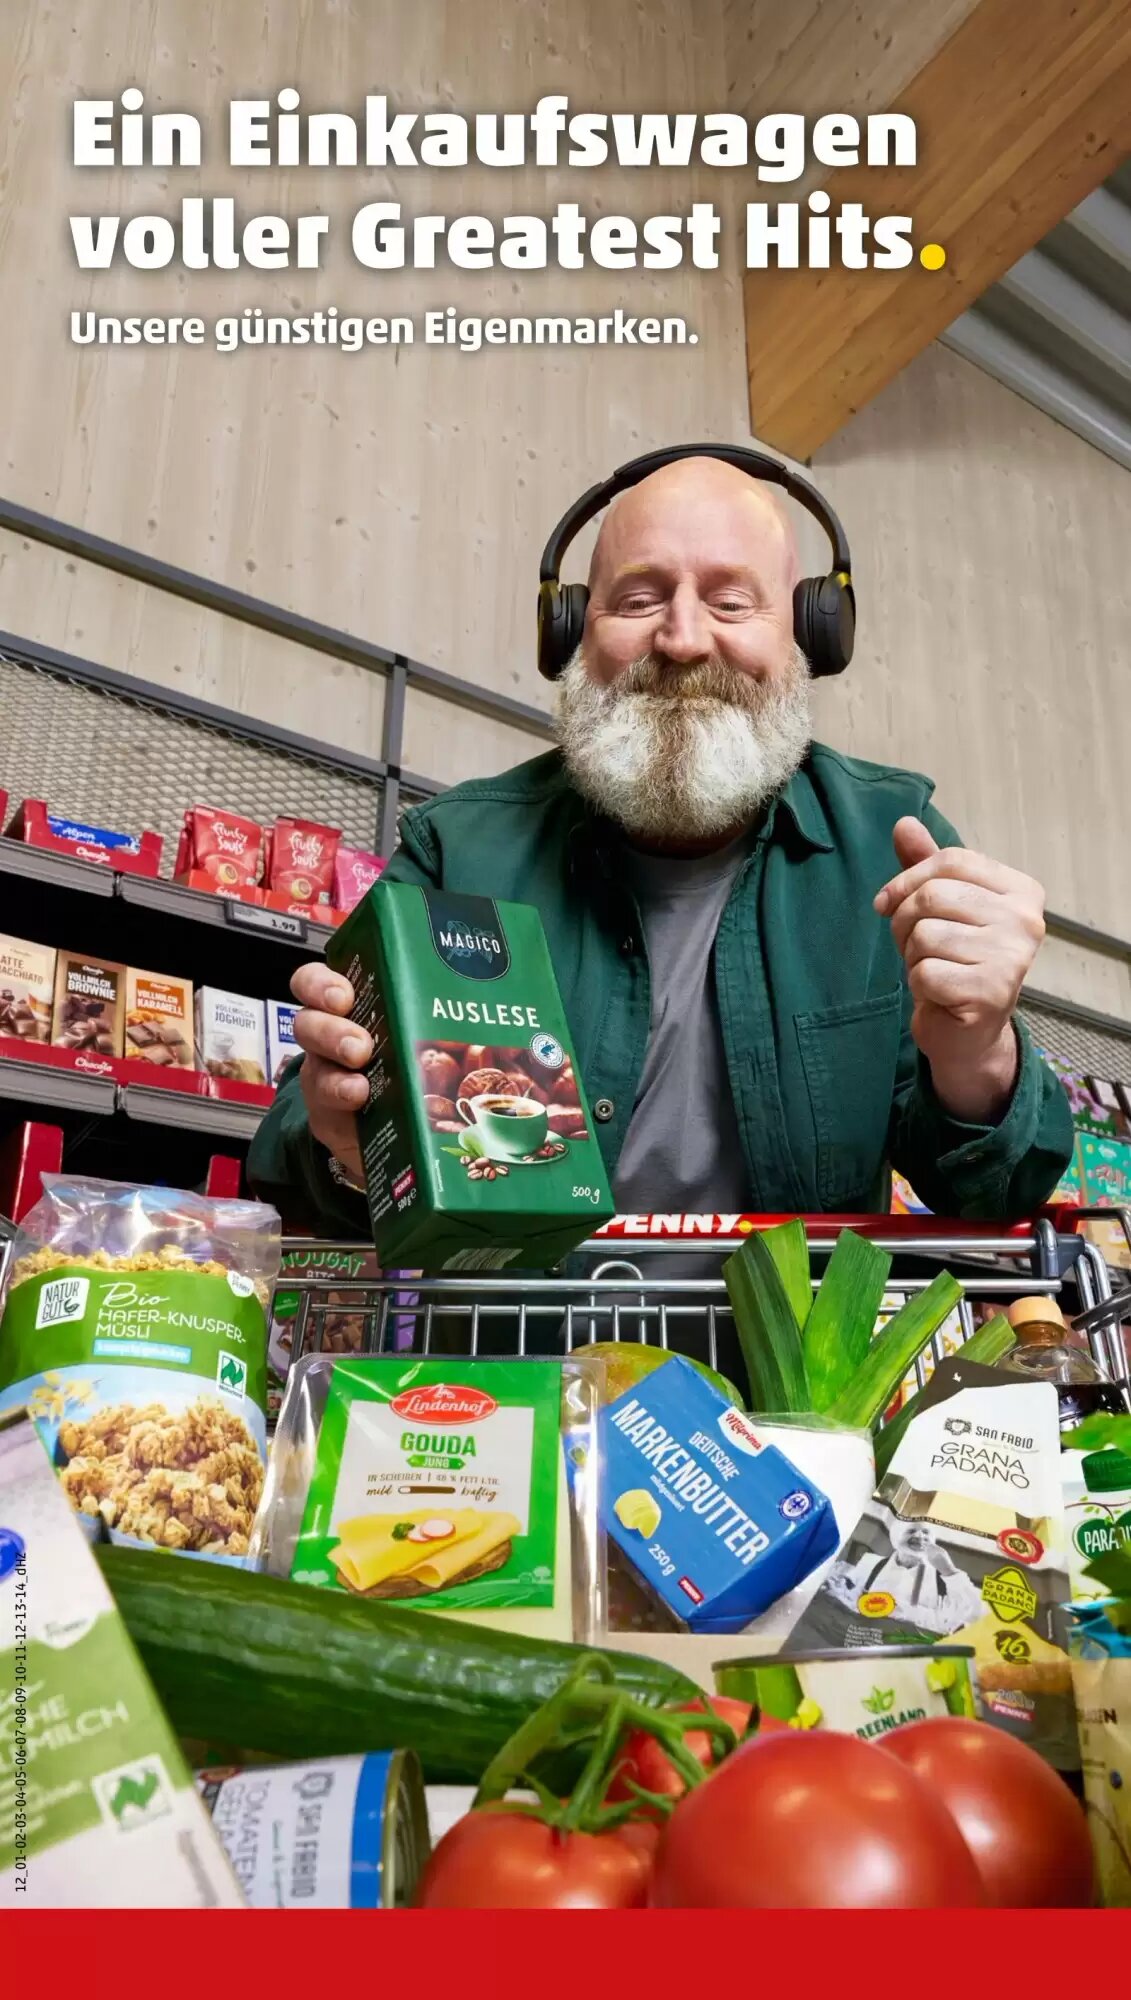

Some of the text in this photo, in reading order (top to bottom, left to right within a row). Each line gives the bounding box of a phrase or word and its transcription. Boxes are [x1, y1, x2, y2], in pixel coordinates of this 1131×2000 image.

[271, 919, 296, 932] 1.99
[439, 931, 501, 954] MAGICO
[67, 971, 112, 989] VOLLMILCH
[67, 980, 117, 1000] BROWNIE
[137, 998, 184, 1017] KARAMELL
[432, 997, 541, 1028] AUSLESE
[214, 1012, 257, 1031] JOGHURT
[280, 1251, 367, 1278] NOUGAT
[45, 1281, 80, 1302] NATUR
[99, 1281, 170, 1308] Bio
[42, 1300, 65, 1321] GUT
[95, 1322, 151, 1339] MÜSLI
[97, 1308, 247, 1344] HAFER-KNUSPER-
[401, 1394, 489, 1416] Lindenhof
[726, 1412, 762, 1451] Milprima
[975, 1426, 998, 1440] SAN
[1001, 1432, 1034, 1449] FABIO
[400, 1432, 477, 1457] GOUDA
[423, 1455, 450, 1468] JUNG
[688, 1431, 742, 1482] DEUTSCHE
[940, 1441, 1026, 1475] GRANA
[380, 1472, 422, 1482] SCHEIBEN
[610, 1399, 771, 1565] MARKENBUTTER
[930, 1454, 1031, 1489] PADANO
[366, 1485, 393, 1496] mild
[648, 1543, 671, 1567] 250
[983, 1590, 1034, 1613] PADANO
[984, 1580, 1035, 1604] GRANA
[999, 1636, 1026, 1656] 16
[855, 1708, 927, 1741] REENLAND
